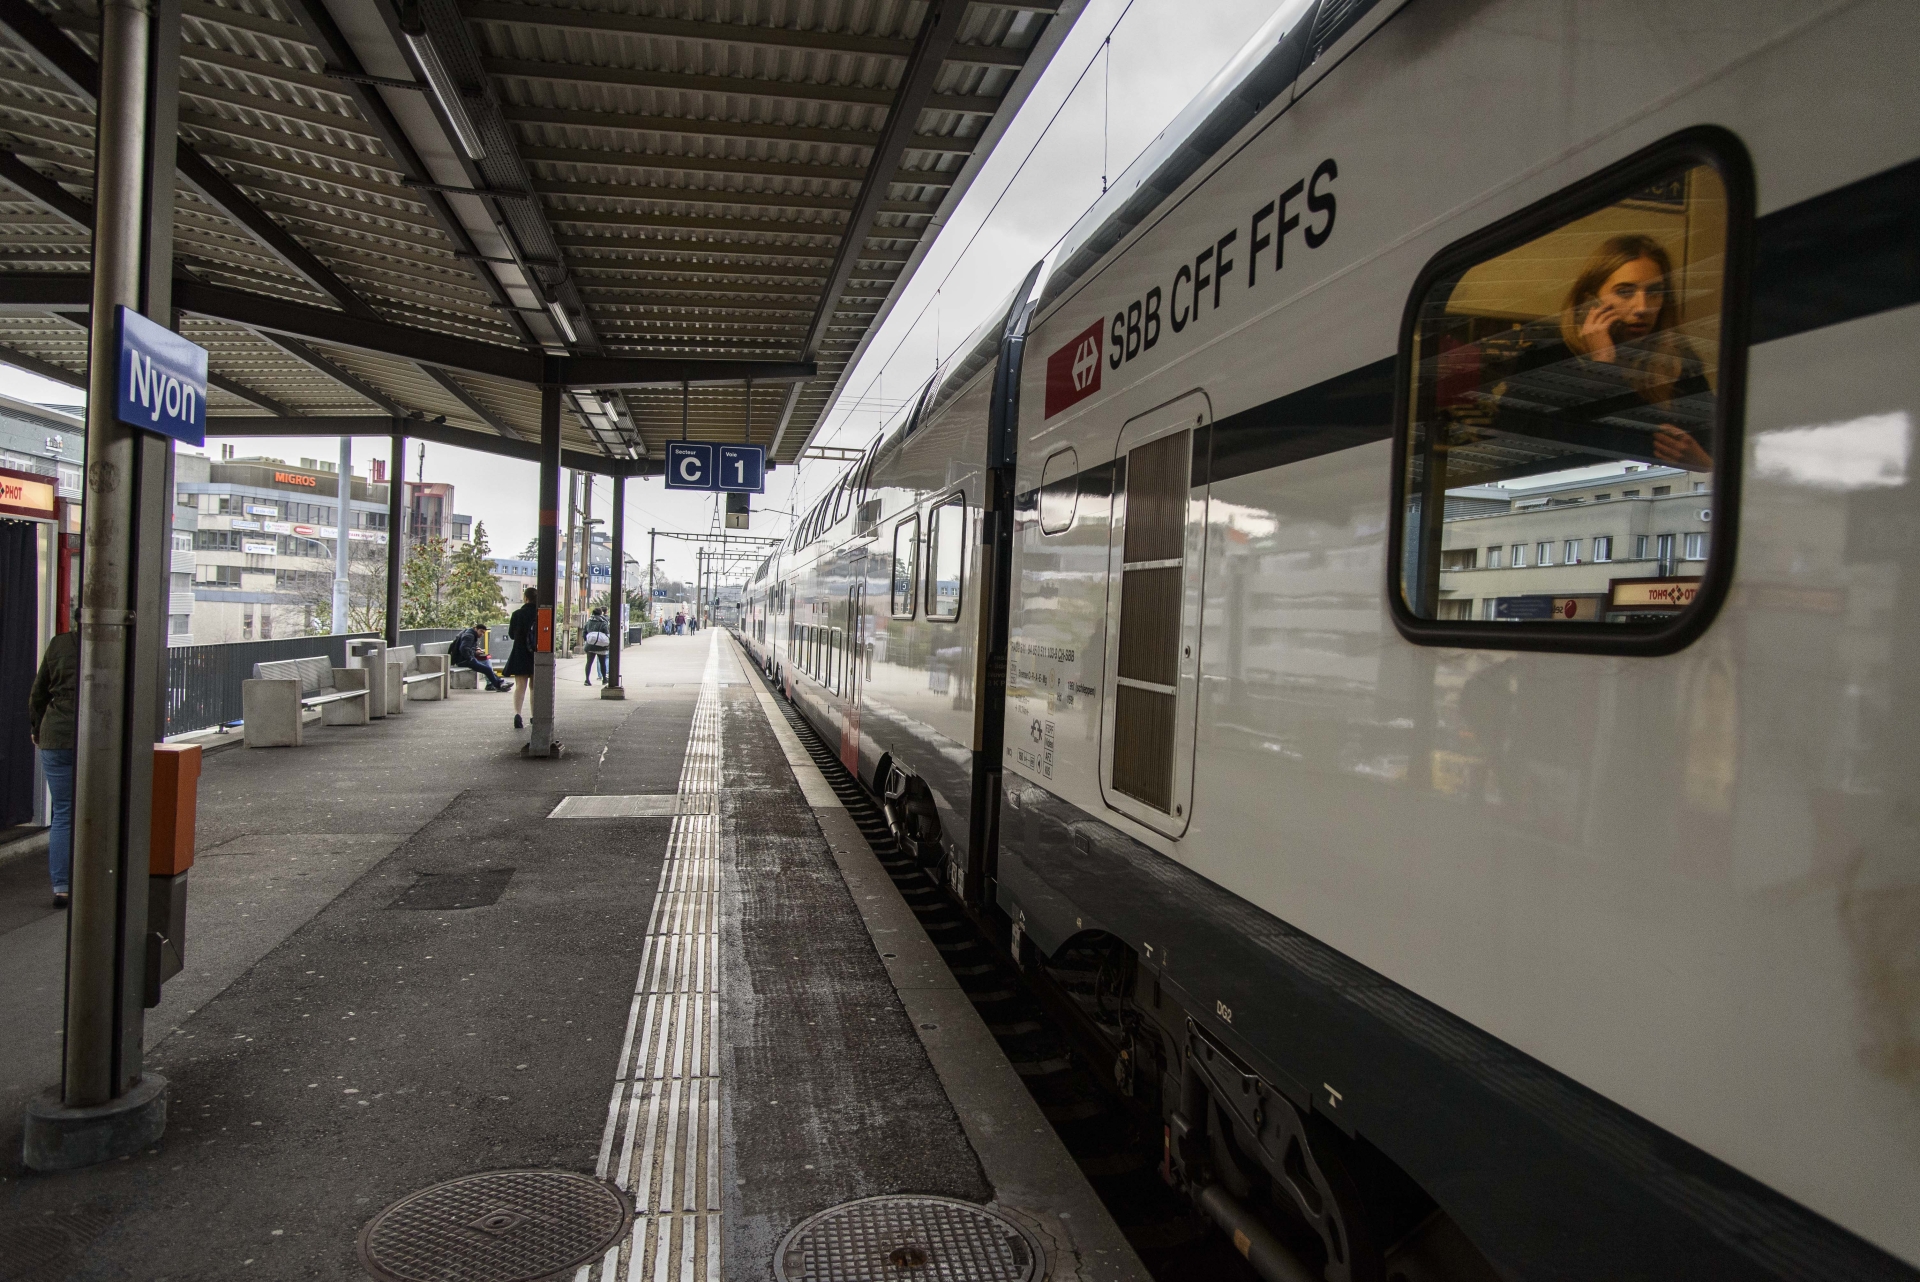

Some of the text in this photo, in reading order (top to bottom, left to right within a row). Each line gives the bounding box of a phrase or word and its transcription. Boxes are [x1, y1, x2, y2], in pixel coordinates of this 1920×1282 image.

[1109, 158, 1339, 370] SBB CFF FFS
[129, 348, 196, 425] Nyon
[675, 448, 697, 456] Secteur
[274, 471, 316, 487] MIGROS
[680, 456, 702, 482] C
[734, 459, 744, 484] 1
[4, 484, 23, 501] PHOT
[735, 515, 740, 528] 1
[593, 566, 600, 574] C
[1216, 999, 1232, 1024] DG2
